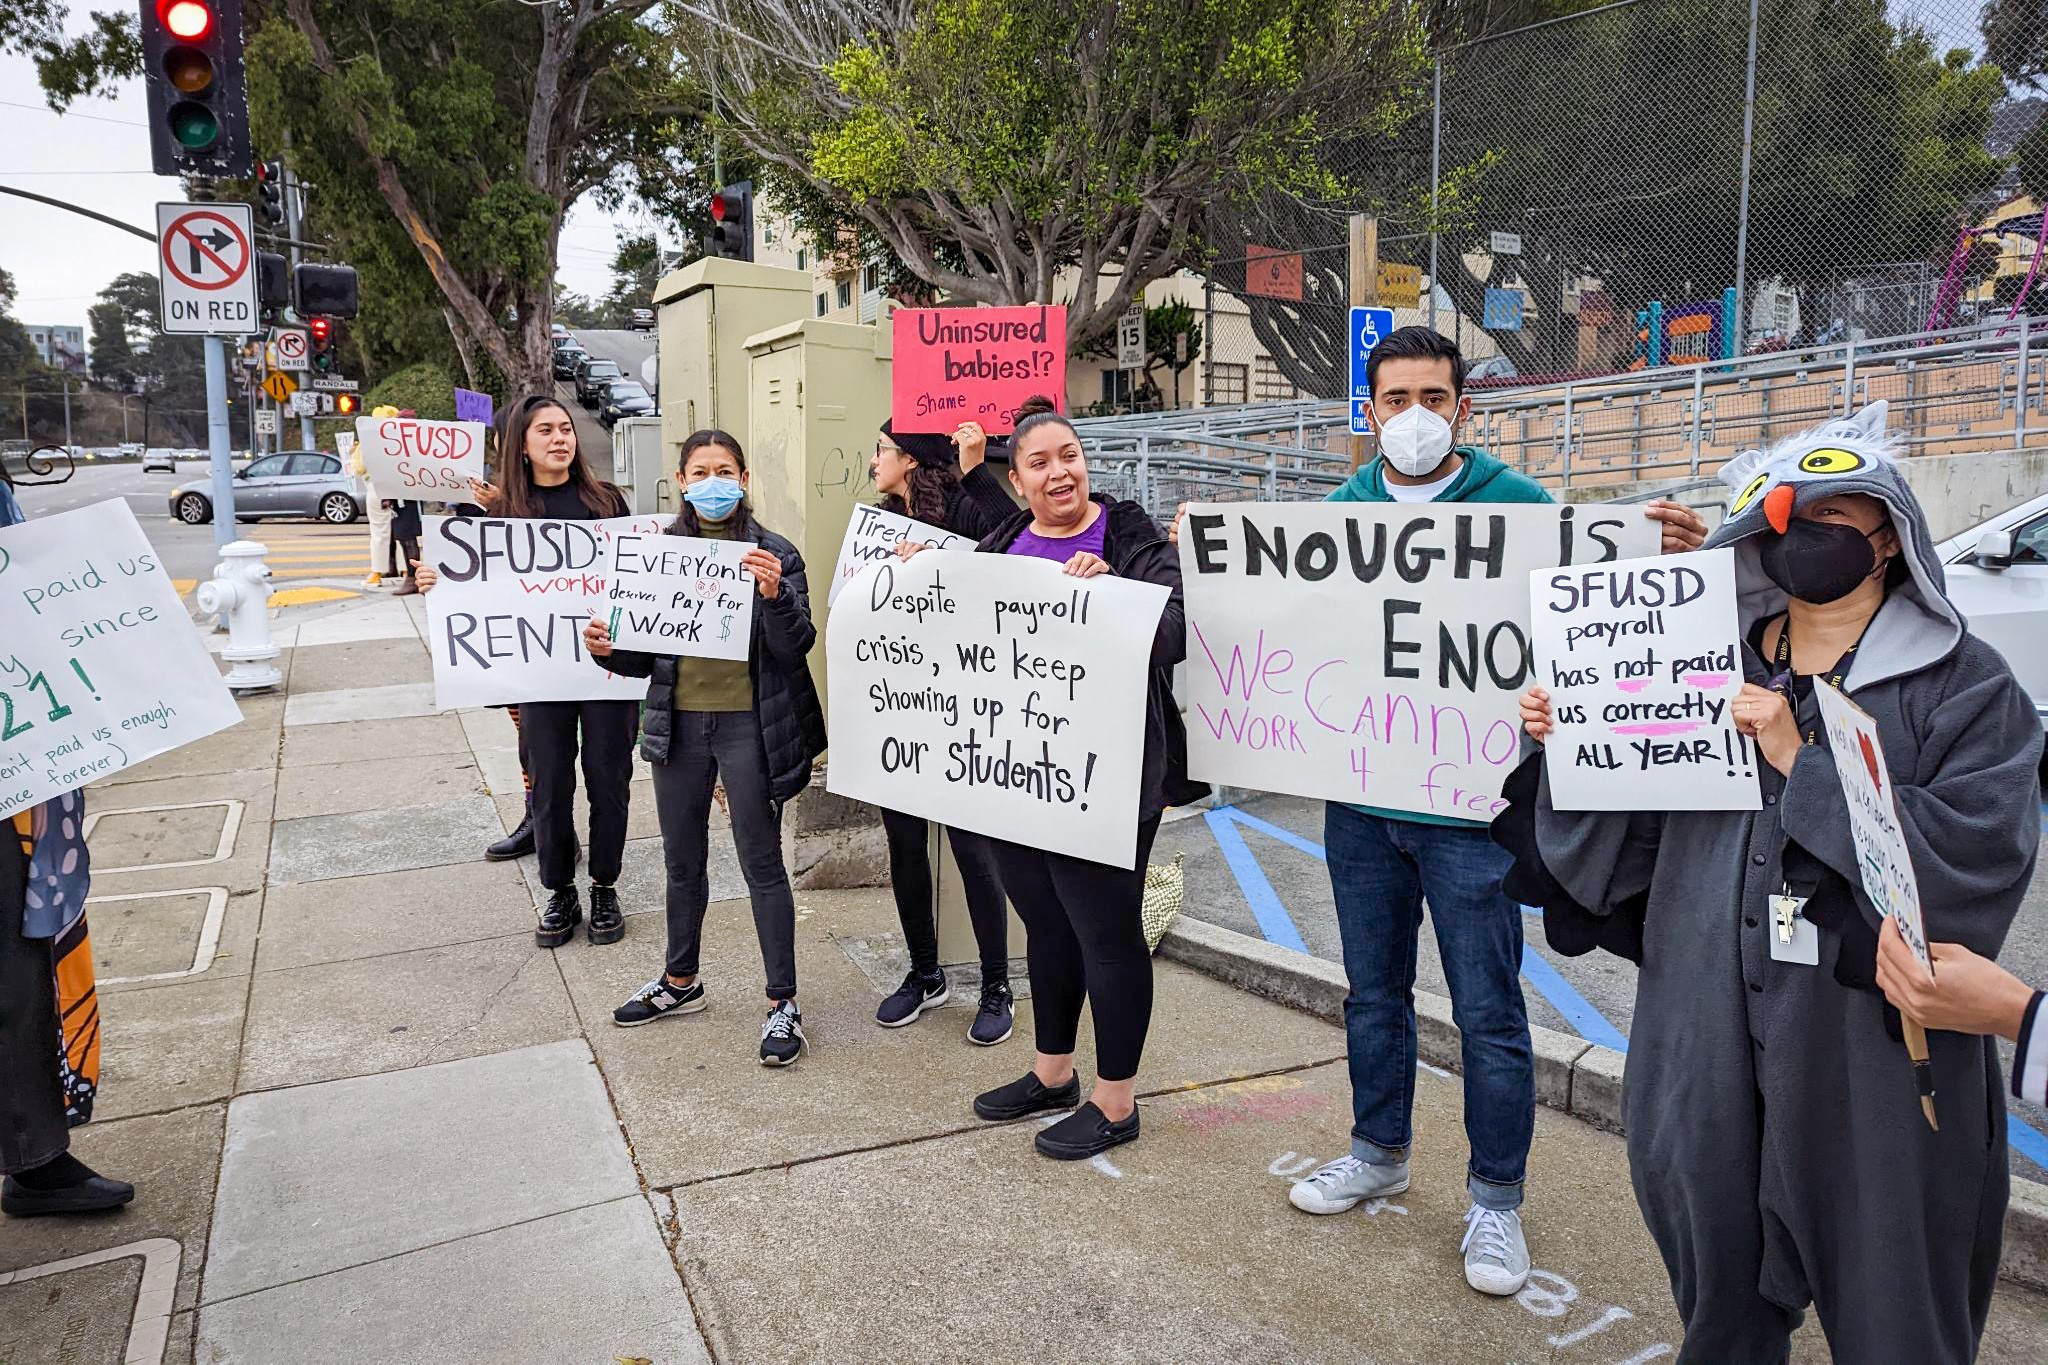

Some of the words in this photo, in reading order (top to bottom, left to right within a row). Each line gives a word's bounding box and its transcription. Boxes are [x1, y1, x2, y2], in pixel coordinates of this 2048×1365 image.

[171, 300, 199, 320] ON
[208, 301, 248, 321] RED
[918, 306, 1047, 346] Uninsured
[1121, 317, 1140, 327] LIMIT
[1123, 306, 1143, 316] EED
[1122, 328, 1140, 347] 15
[281, 359, 291, 367] ON
[293, 359, 306, 367] RED
[944, 349, 1055, 382] babies!?
[315, 380, 356, 388] RANDALL
[916, 392, 966, 417] Shame
[978, 402, 996, 414] on
[259, 422, 274, 432] 45
[379, 421, 473, 460] SFUSD
[397, 461, 465, 489] S.O.S.
[859, 507, 912, 544] Tired
[438, 516, 604, 582] SFUSD:
[1188, 514, 1506, 583] ENOUGH
[23, 560, 107, 615] paid
[118, 554, 156, 576] us
[609, 578, 657, 602] deserves
[717, 593, 744, 611] for
[871, 564, 956, 624] Despite
[994, 588, 1091, 635] payroll
[1548, 566, 1706, 614] SFUSD
[60, 605, 158, 648] since
[446, 612, 591, 670] RENT
[629, 610, 703, 642] WORK
[1565, 610, 1665, 652] payroll
[956, 642, 997, 673] we
[1012, 637, 1087, 702] keep
[1192, 620, 1295, 701] We
[1551, 659, 1601, 689] has
[1613, 647, 1663, 679] not
[1671, 644, 1736, 685] paid
[973, 696, 1004, 738] up
[1020, 690, 1070, 735] for
[1557, 703, 1588, 724] us
[1602, 691, 1726, 726] correctly
[44, 734, 84, 767] paid
[91, 727, 112, 742] us
[121, 699, 177, 731] enough
[1196, 702, 1308, 754] WORK
[1349, 746, 1375, 793] 4
[1419, 762, 1508, 817] free
[1575, 743, 1623, 770] ALL
